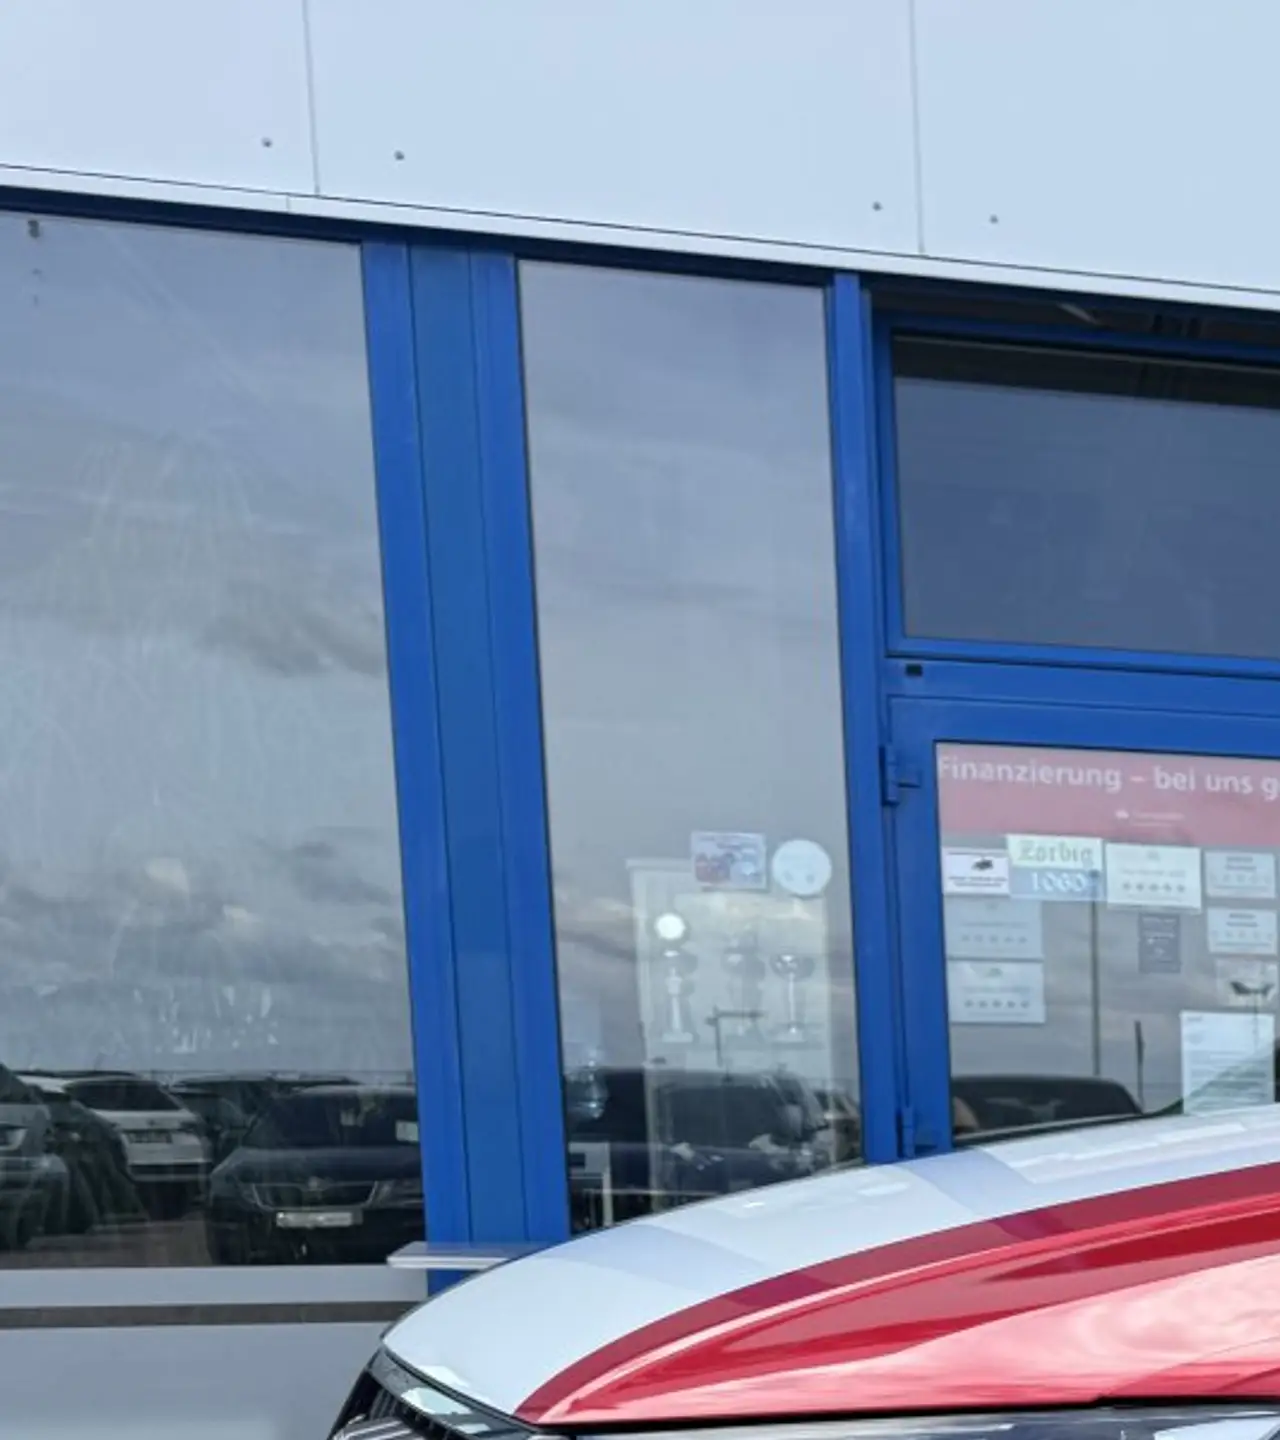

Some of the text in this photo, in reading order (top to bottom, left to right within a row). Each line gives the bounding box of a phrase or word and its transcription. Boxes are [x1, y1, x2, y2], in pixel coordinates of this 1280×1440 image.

[938, 756, 1123, 794] Finanzierung
[1153, 766, 1196, 791] bei
[1205, 773, 1253, 795] uns
